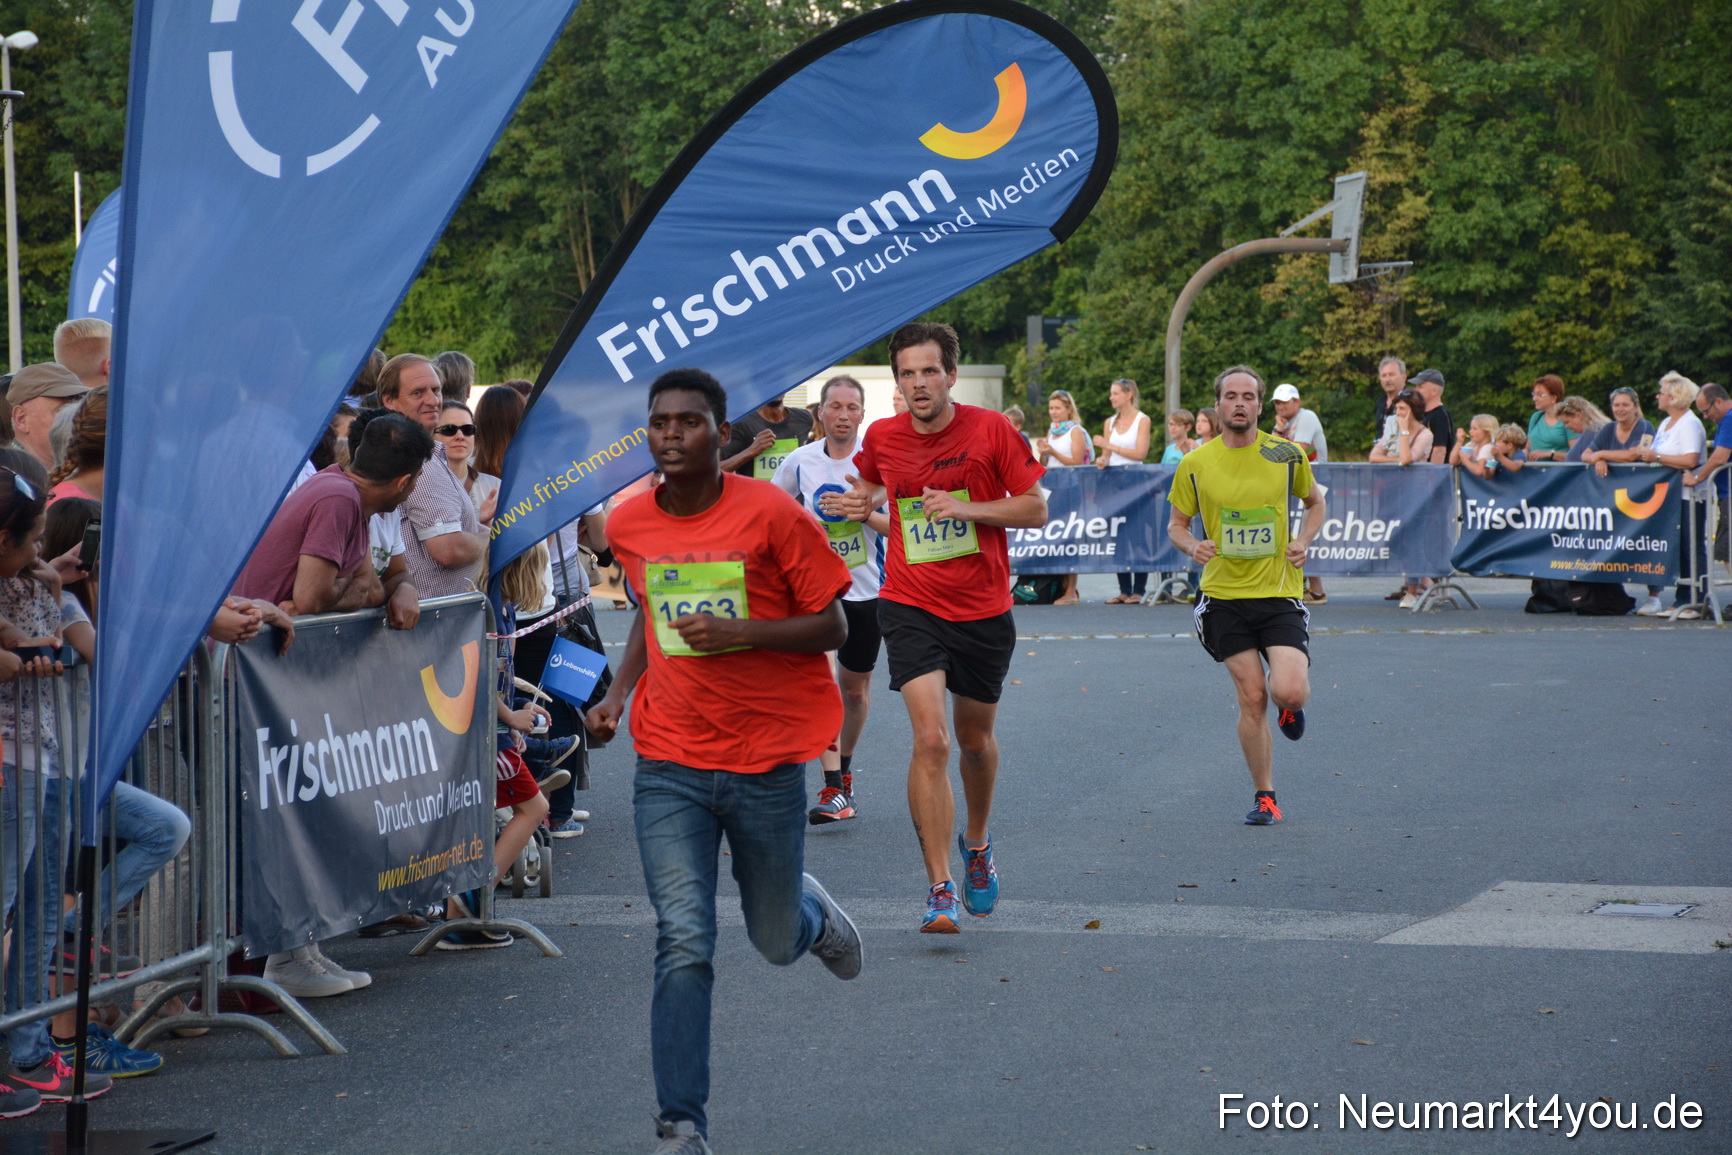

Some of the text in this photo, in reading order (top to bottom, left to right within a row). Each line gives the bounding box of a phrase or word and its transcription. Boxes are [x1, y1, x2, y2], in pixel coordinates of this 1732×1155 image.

[831, 147, 1081, 293] Druck und Medien
[596, 168, 957, 383] Frischmann
[1466, 499, 1614, 531] Frischmann
[909, 519, 968, 544] 1479
[1226, 527, 1272, 545] 1173
[1551, 533, 1668, 552] Druck und Medien
[1008, 543, 1116, 557] AUTOMOBILE
[1550, 558, 1666, 575] www.frischmann-net.de
[659, 597, 738, 622] 1663
[562, 659, 598, 679] Lebenshilfe
[256, 713, 438, 810] Frischmann
[374, 792, 415, 835] Druck
[416, 783, 443, 824] und
